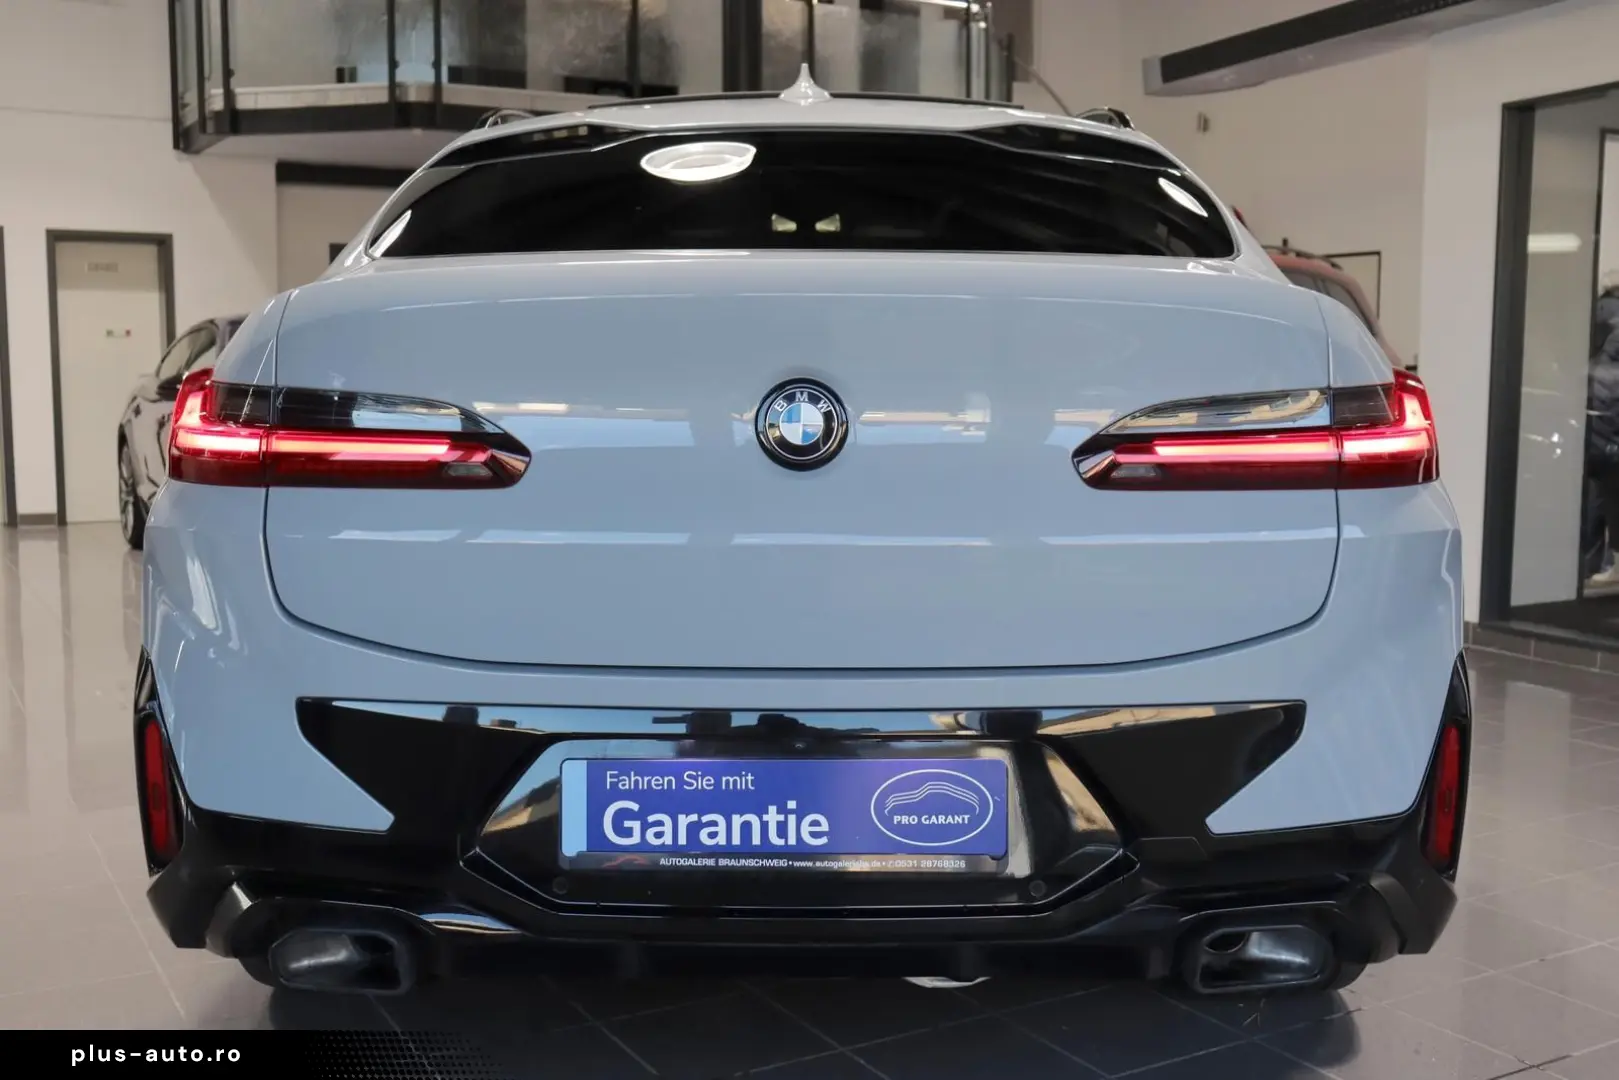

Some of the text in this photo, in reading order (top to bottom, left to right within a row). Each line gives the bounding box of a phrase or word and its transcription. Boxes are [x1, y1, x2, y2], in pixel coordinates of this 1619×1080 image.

[774, 391, 832, 413] BMW
[605, 770, 755, 790] Fahren Sie mit
[602, 800, 830, 846] Garantie
[893, 814, 970, 825] PRO GARANT
[659, 857, 716, 866] AUTOGALERIE
[718, 858, 788, 867] BRAUNSCHWEIG
